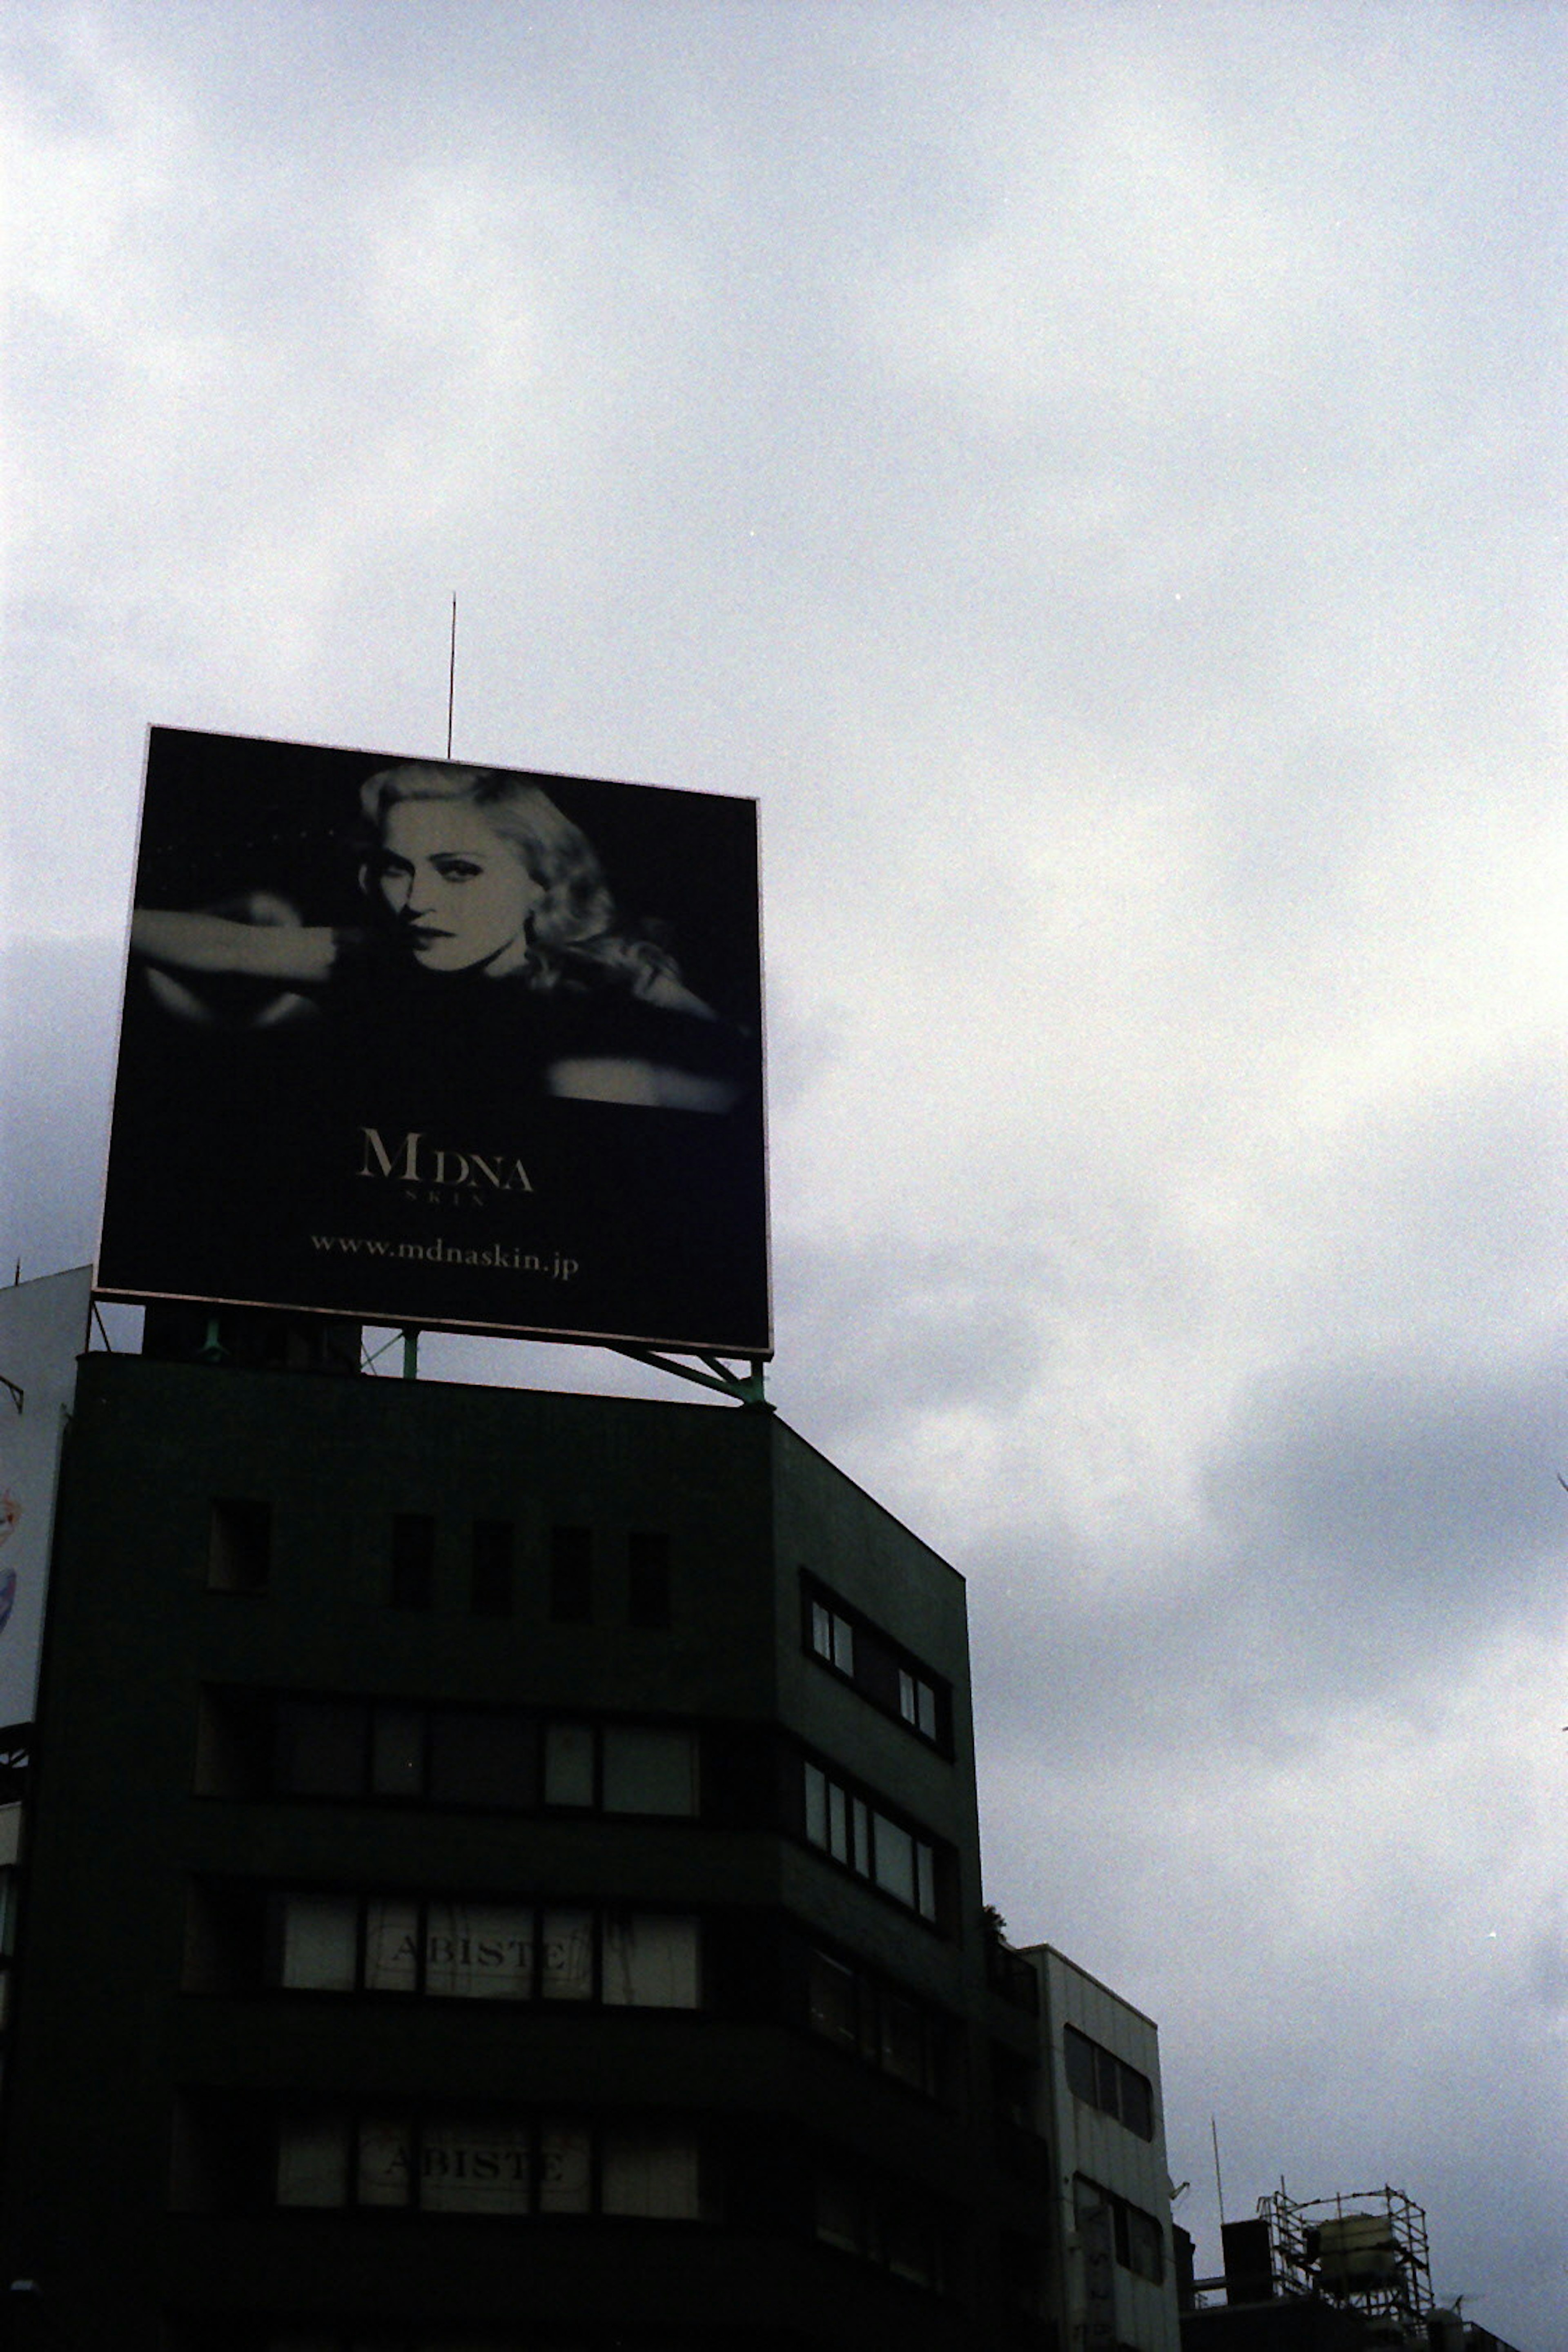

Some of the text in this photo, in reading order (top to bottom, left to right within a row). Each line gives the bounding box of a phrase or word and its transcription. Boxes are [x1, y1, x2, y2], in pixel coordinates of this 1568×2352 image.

[358, 1127, 534, 1192] MDNA
[310, 1234, 580, 1281] www.mdnaskin.jp
[391, 1935, 565, 1970] ABISTE
[385, 2145, 564, 2181] ABISTE
